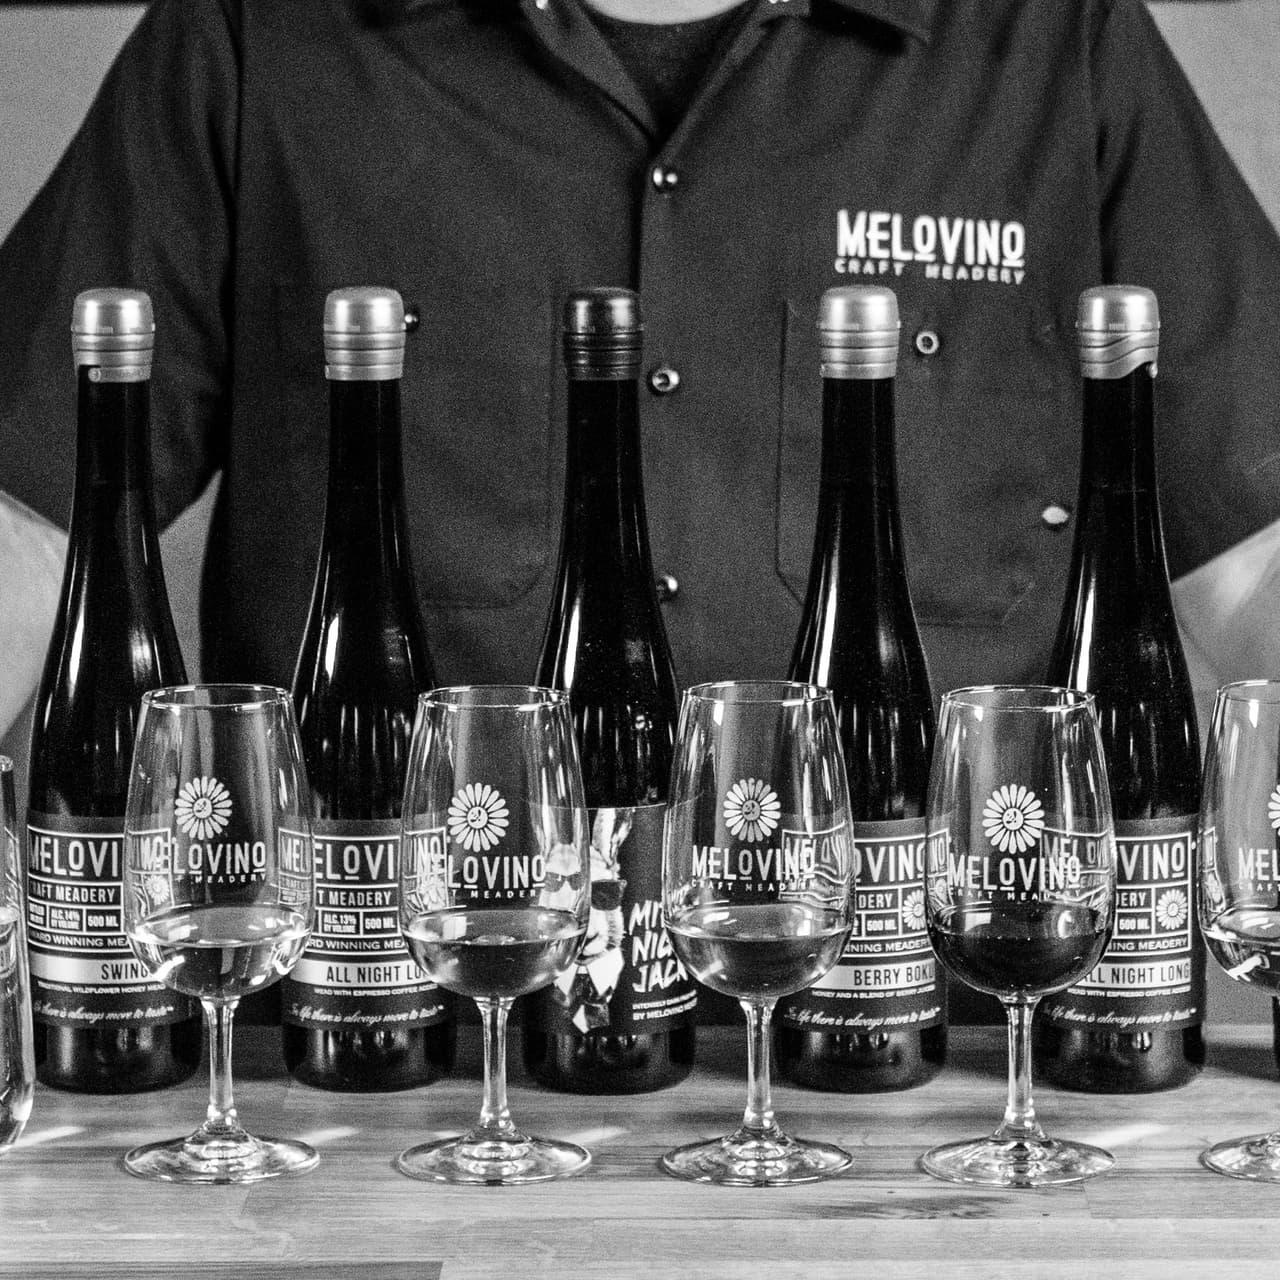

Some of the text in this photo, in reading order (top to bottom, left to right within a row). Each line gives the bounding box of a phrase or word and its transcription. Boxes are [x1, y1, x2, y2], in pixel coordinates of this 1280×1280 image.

[836, 208, 1025, 267] MELOVINO
[834, 258, 1025, 284] CRAFT MEADERY
[29, 835, 118, 877] MELOVI
[692, 845, 815, 880] MELOVINO
[1119, 841, 1185, 881] VINO
[447, 854, 546, 889] LOVINO
[949, 853, 1080, 890] MELOVINO
[55, 885, 115, 903] MEADERY
[329, 891, 391, 906] MEADERY
[470, 889, 536, 899] MEADER
[858, 893, 893, 908] DERY
[105, 915, 119, 927] ML
[382, 917, 396, 929] ML
[52, 935, 104, 947] WINNING
[325, 940, 380, 950] WINNING
[632, 930, 672, 966] NIG
[1138, 937, 1187, 951] MEADERY
[101, 963, 148, 980] SWING
[326, 965, 423, 983] ALL NIGHT LO
[854, 968, 900, 986] BERRY
[1111, 967, 1154, 984] NIGHT
[1161, 963, 1190, 982] LONG
